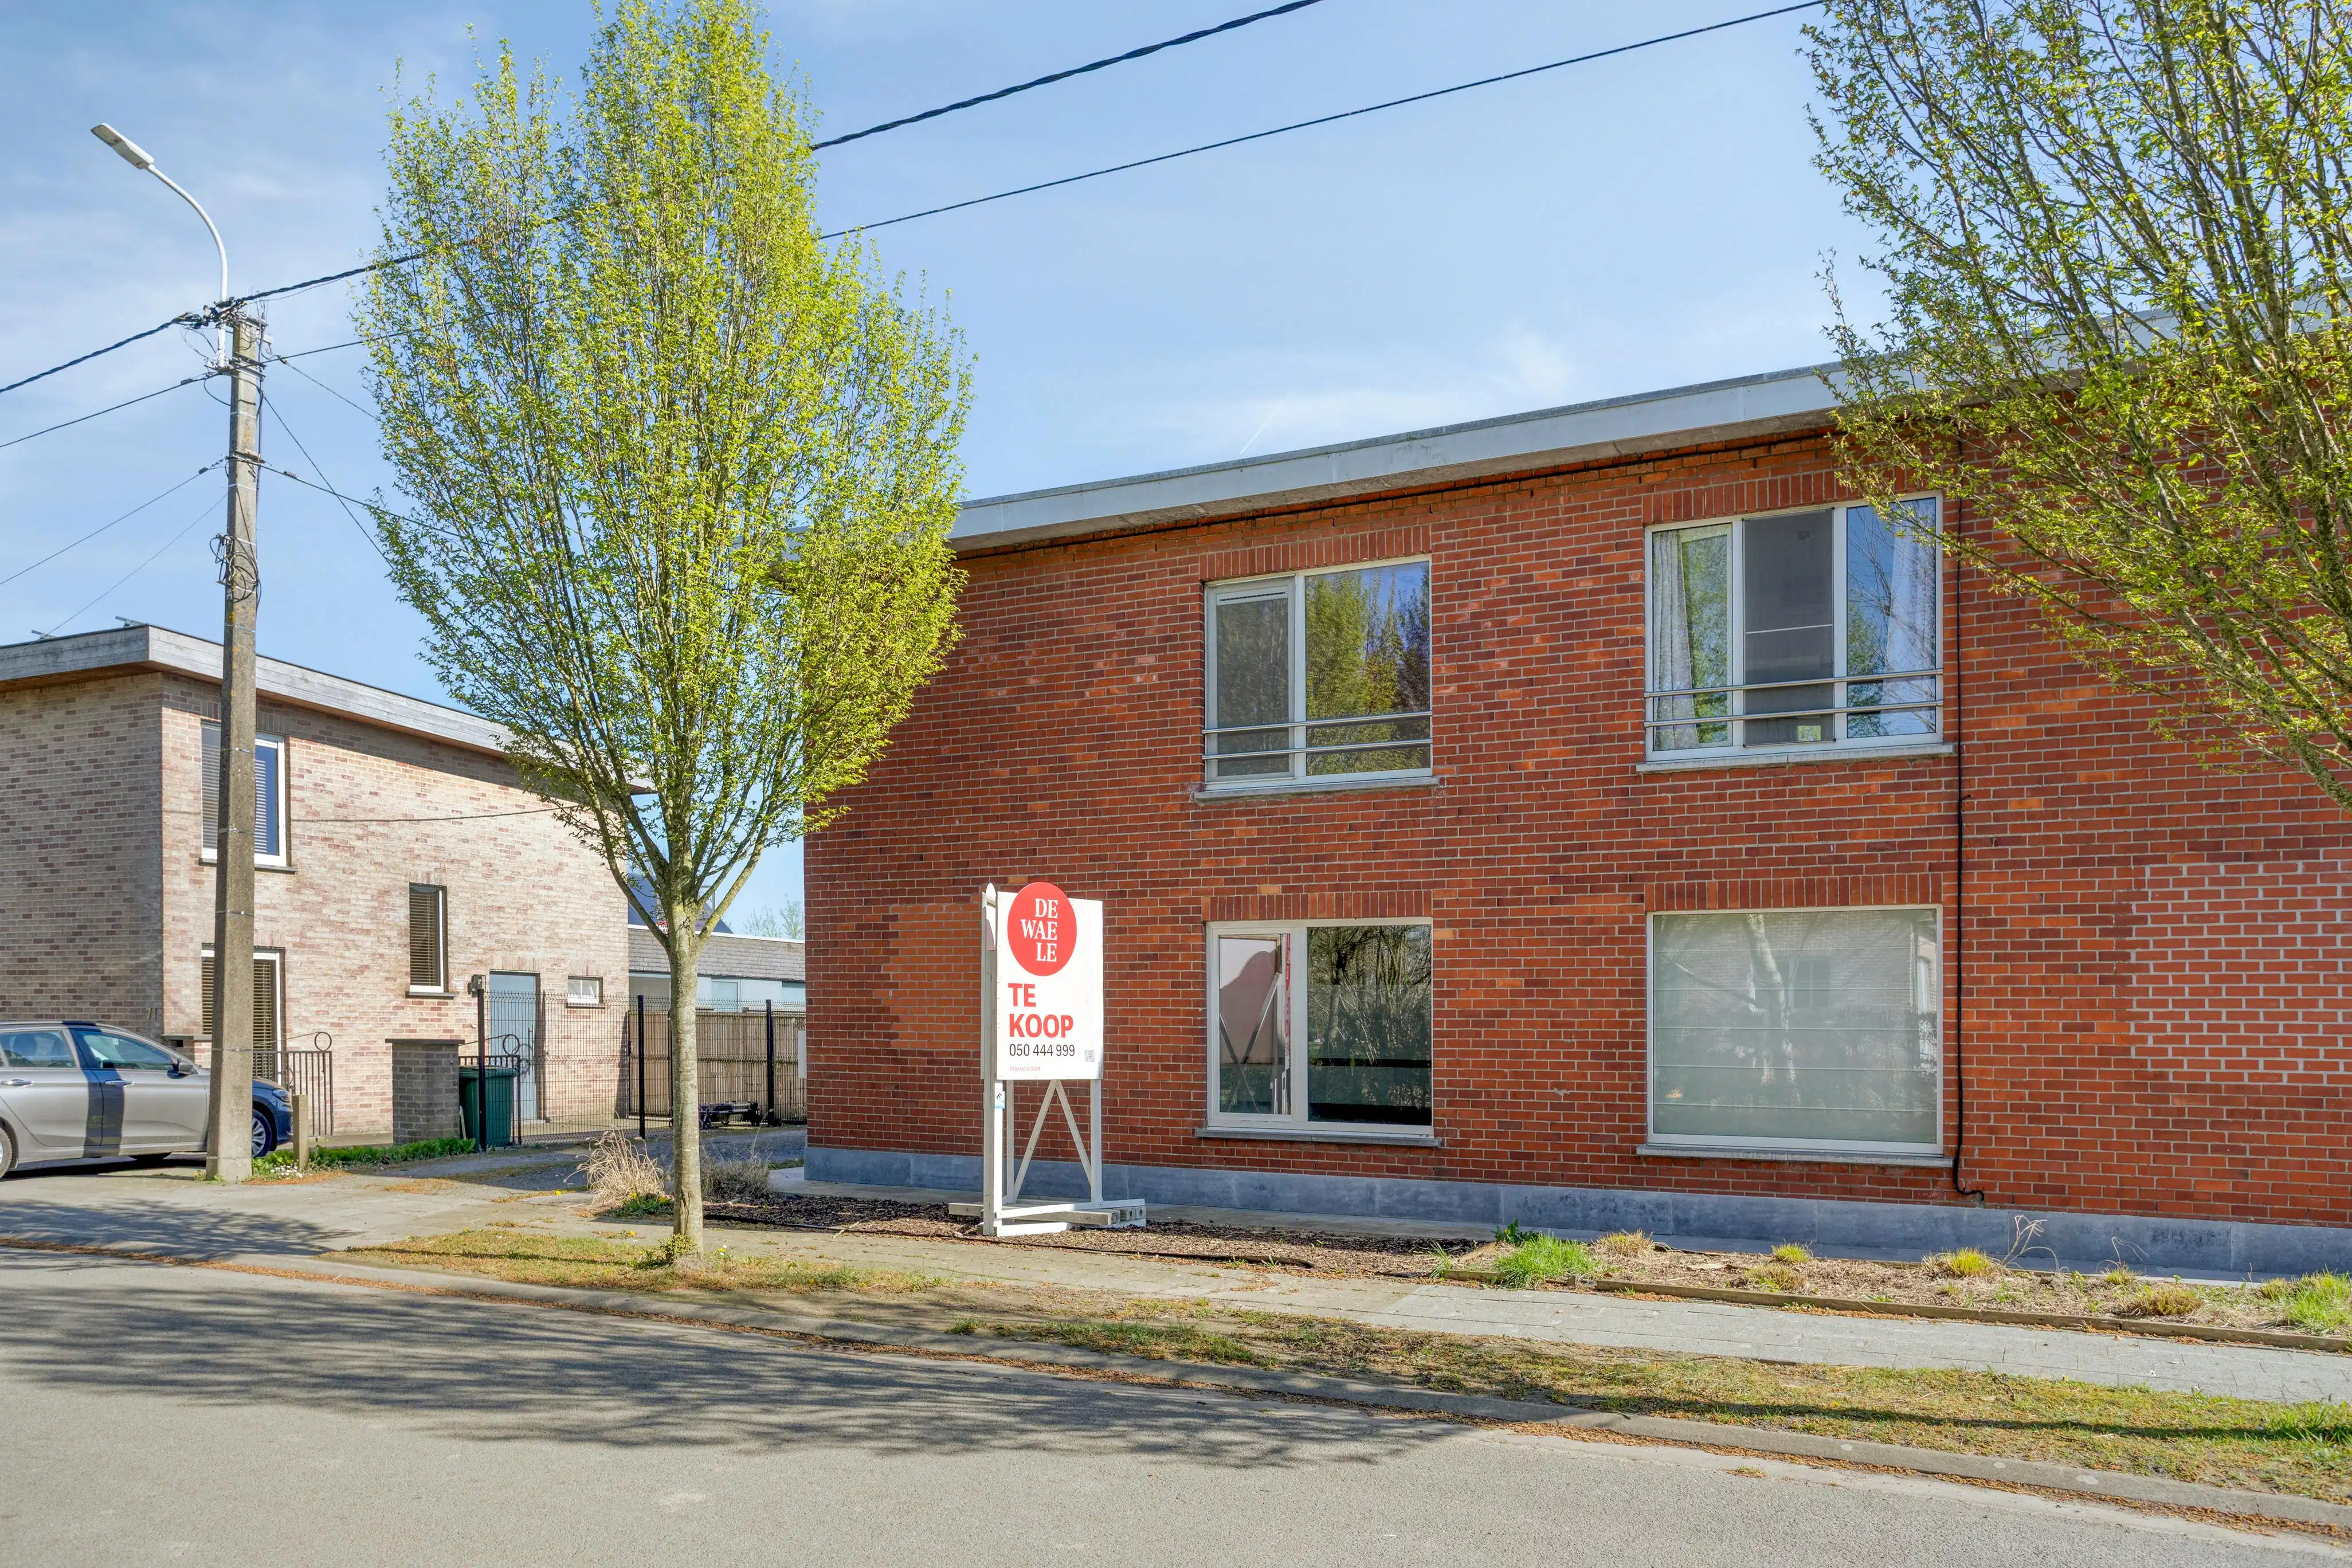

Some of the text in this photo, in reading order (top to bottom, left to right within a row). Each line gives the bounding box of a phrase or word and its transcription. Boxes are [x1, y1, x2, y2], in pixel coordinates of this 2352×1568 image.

[1034, 898, 1059, 919] DE
[1020, 919, 1058, 940] WAE
[1036, 942, 1057, 962] LE
[1008, 983, 1036, 1007] TE
[1009, 1013, 1073, 1038] KOOP
[1009, 1044, 1075, 1057] 050 444 999
